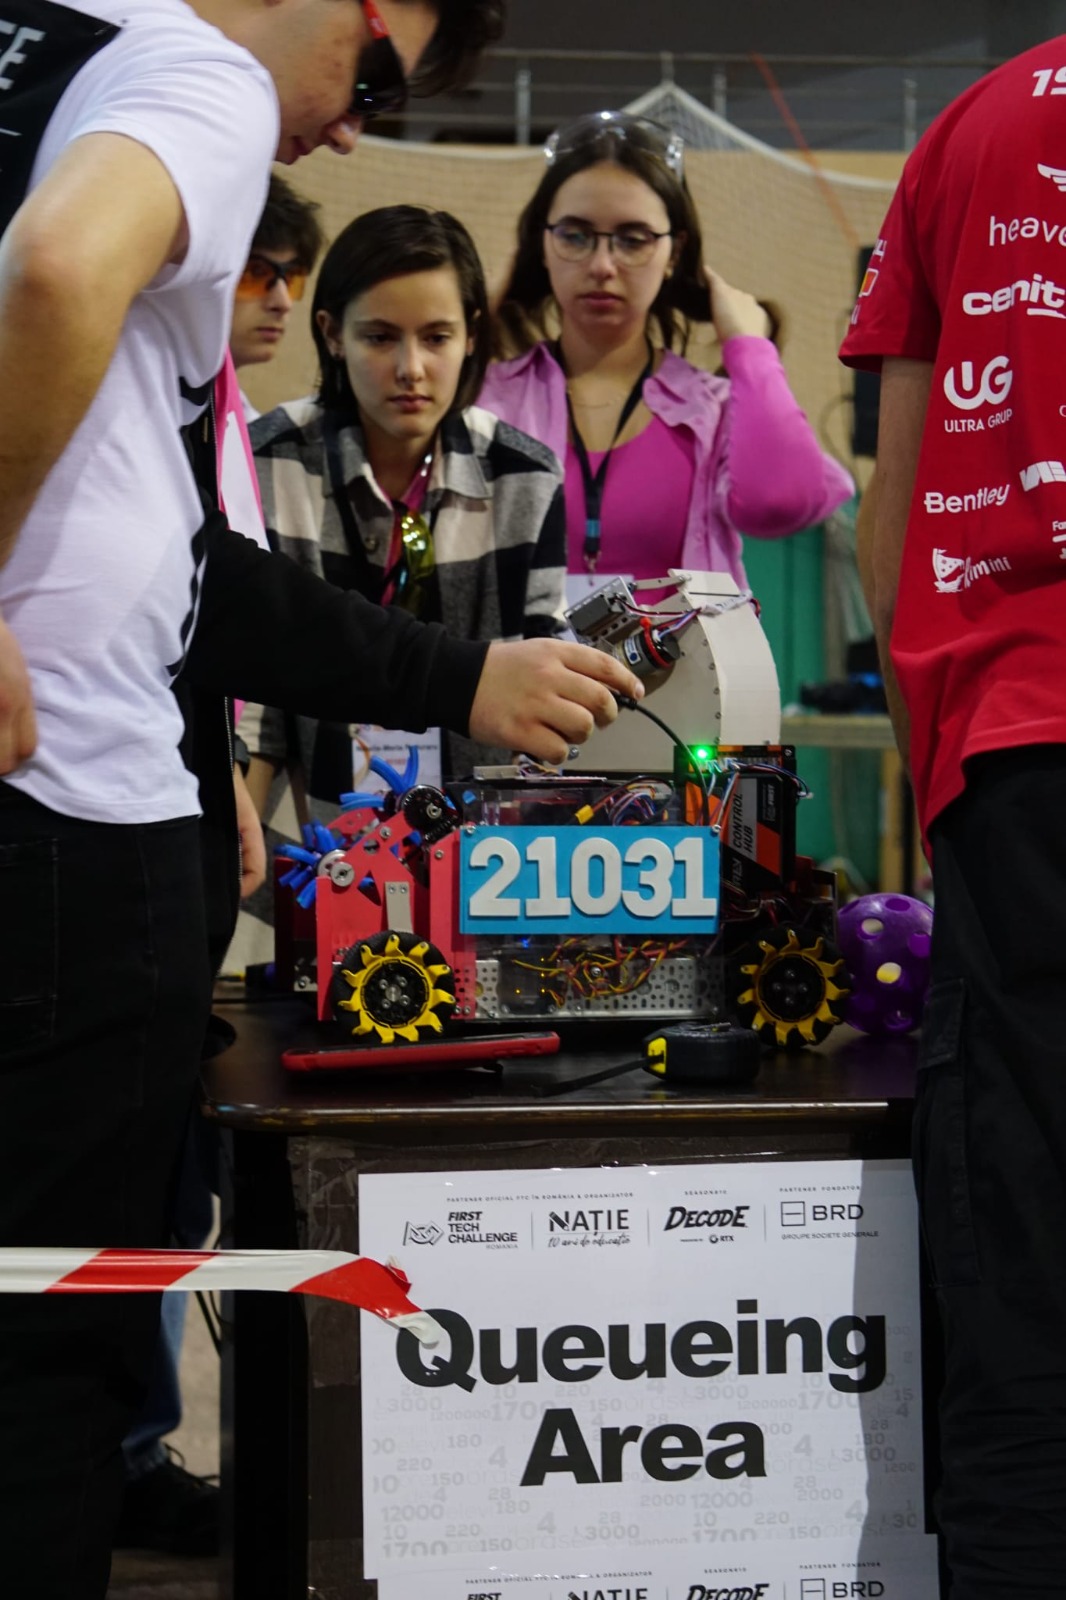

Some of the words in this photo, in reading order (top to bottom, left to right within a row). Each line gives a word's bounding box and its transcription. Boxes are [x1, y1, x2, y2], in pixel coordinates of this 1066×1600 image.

[944, 418, 985, 433] ULTRA
[988, 408, 1013, 429] GRUP
[924, 484, 1010, 514] Bentley
[732, 792, 744, 849] CONTROL
[742, 825, 755, 854] HUB
[468, 836, 717, 918] 21031
[448, 1211, 483, 1221] FIRST
[664, 1205, 750, 1231] DECODE
[812, 1204, 865, 1221] BRD
[448, 1222, 480, 1233] TECH
[448, 1232, 518, 1244] CHALLENGE
[396, 1299, 887, 1394] Queueing
[447, 1433, 482, 1449] 180
[519, 1408, 767, 1487] Area
[396, 1457, 433, 1472] 220
[432, 1471, 465, 1486] 150
[640, 1493, 687, 1507] 2000
[691, 1490, 754, 1510] 12000
[797, 1488, 844, 1501] 2000
[380, 1503, 445, 1522] 12000
[496, 1499, 531, 1514] 180
[754, 1511, 790, 1525] 220
[444, 1523, 481, 1538] 220
[479, 1537, 513, 1552] 150
[832, 1581, 885, 1598] BRD
